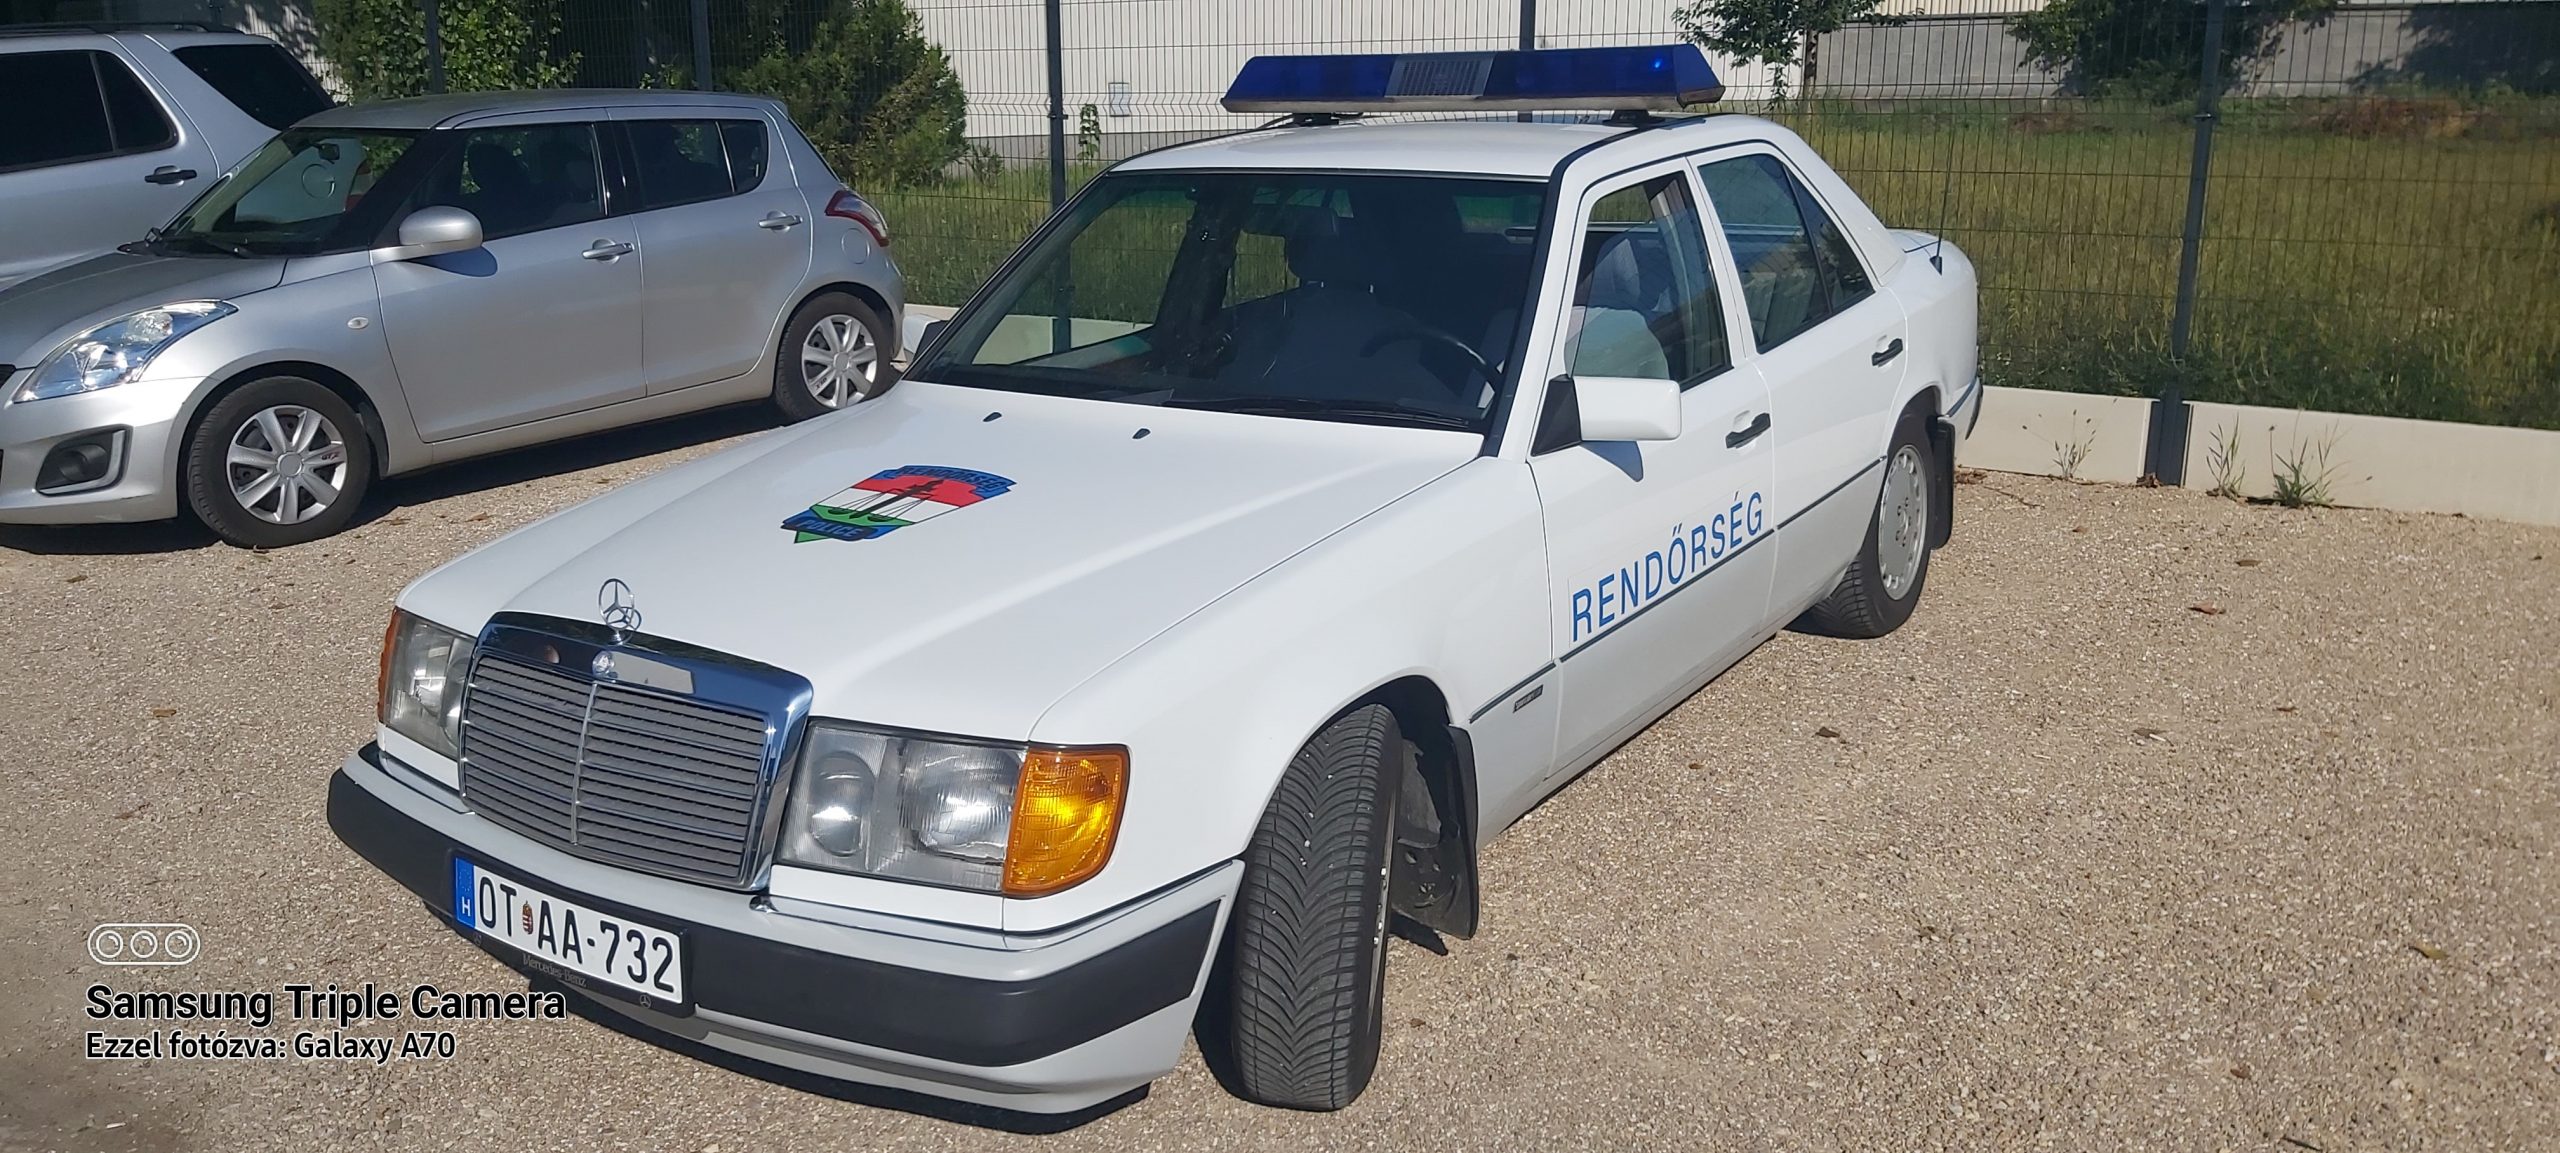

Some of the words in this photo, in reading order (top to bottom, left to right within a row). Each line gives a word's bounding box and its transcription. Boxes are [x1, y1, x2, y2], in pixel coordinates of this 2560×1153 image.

[796, 520, 863, 537] POLICE
[1572, 491, 1762, 642] RENDŐRSÉG
[461, 895, 471, 917] H
[478, 876, 517, 937] OT
[537, 900, 675, 993] AA-732
